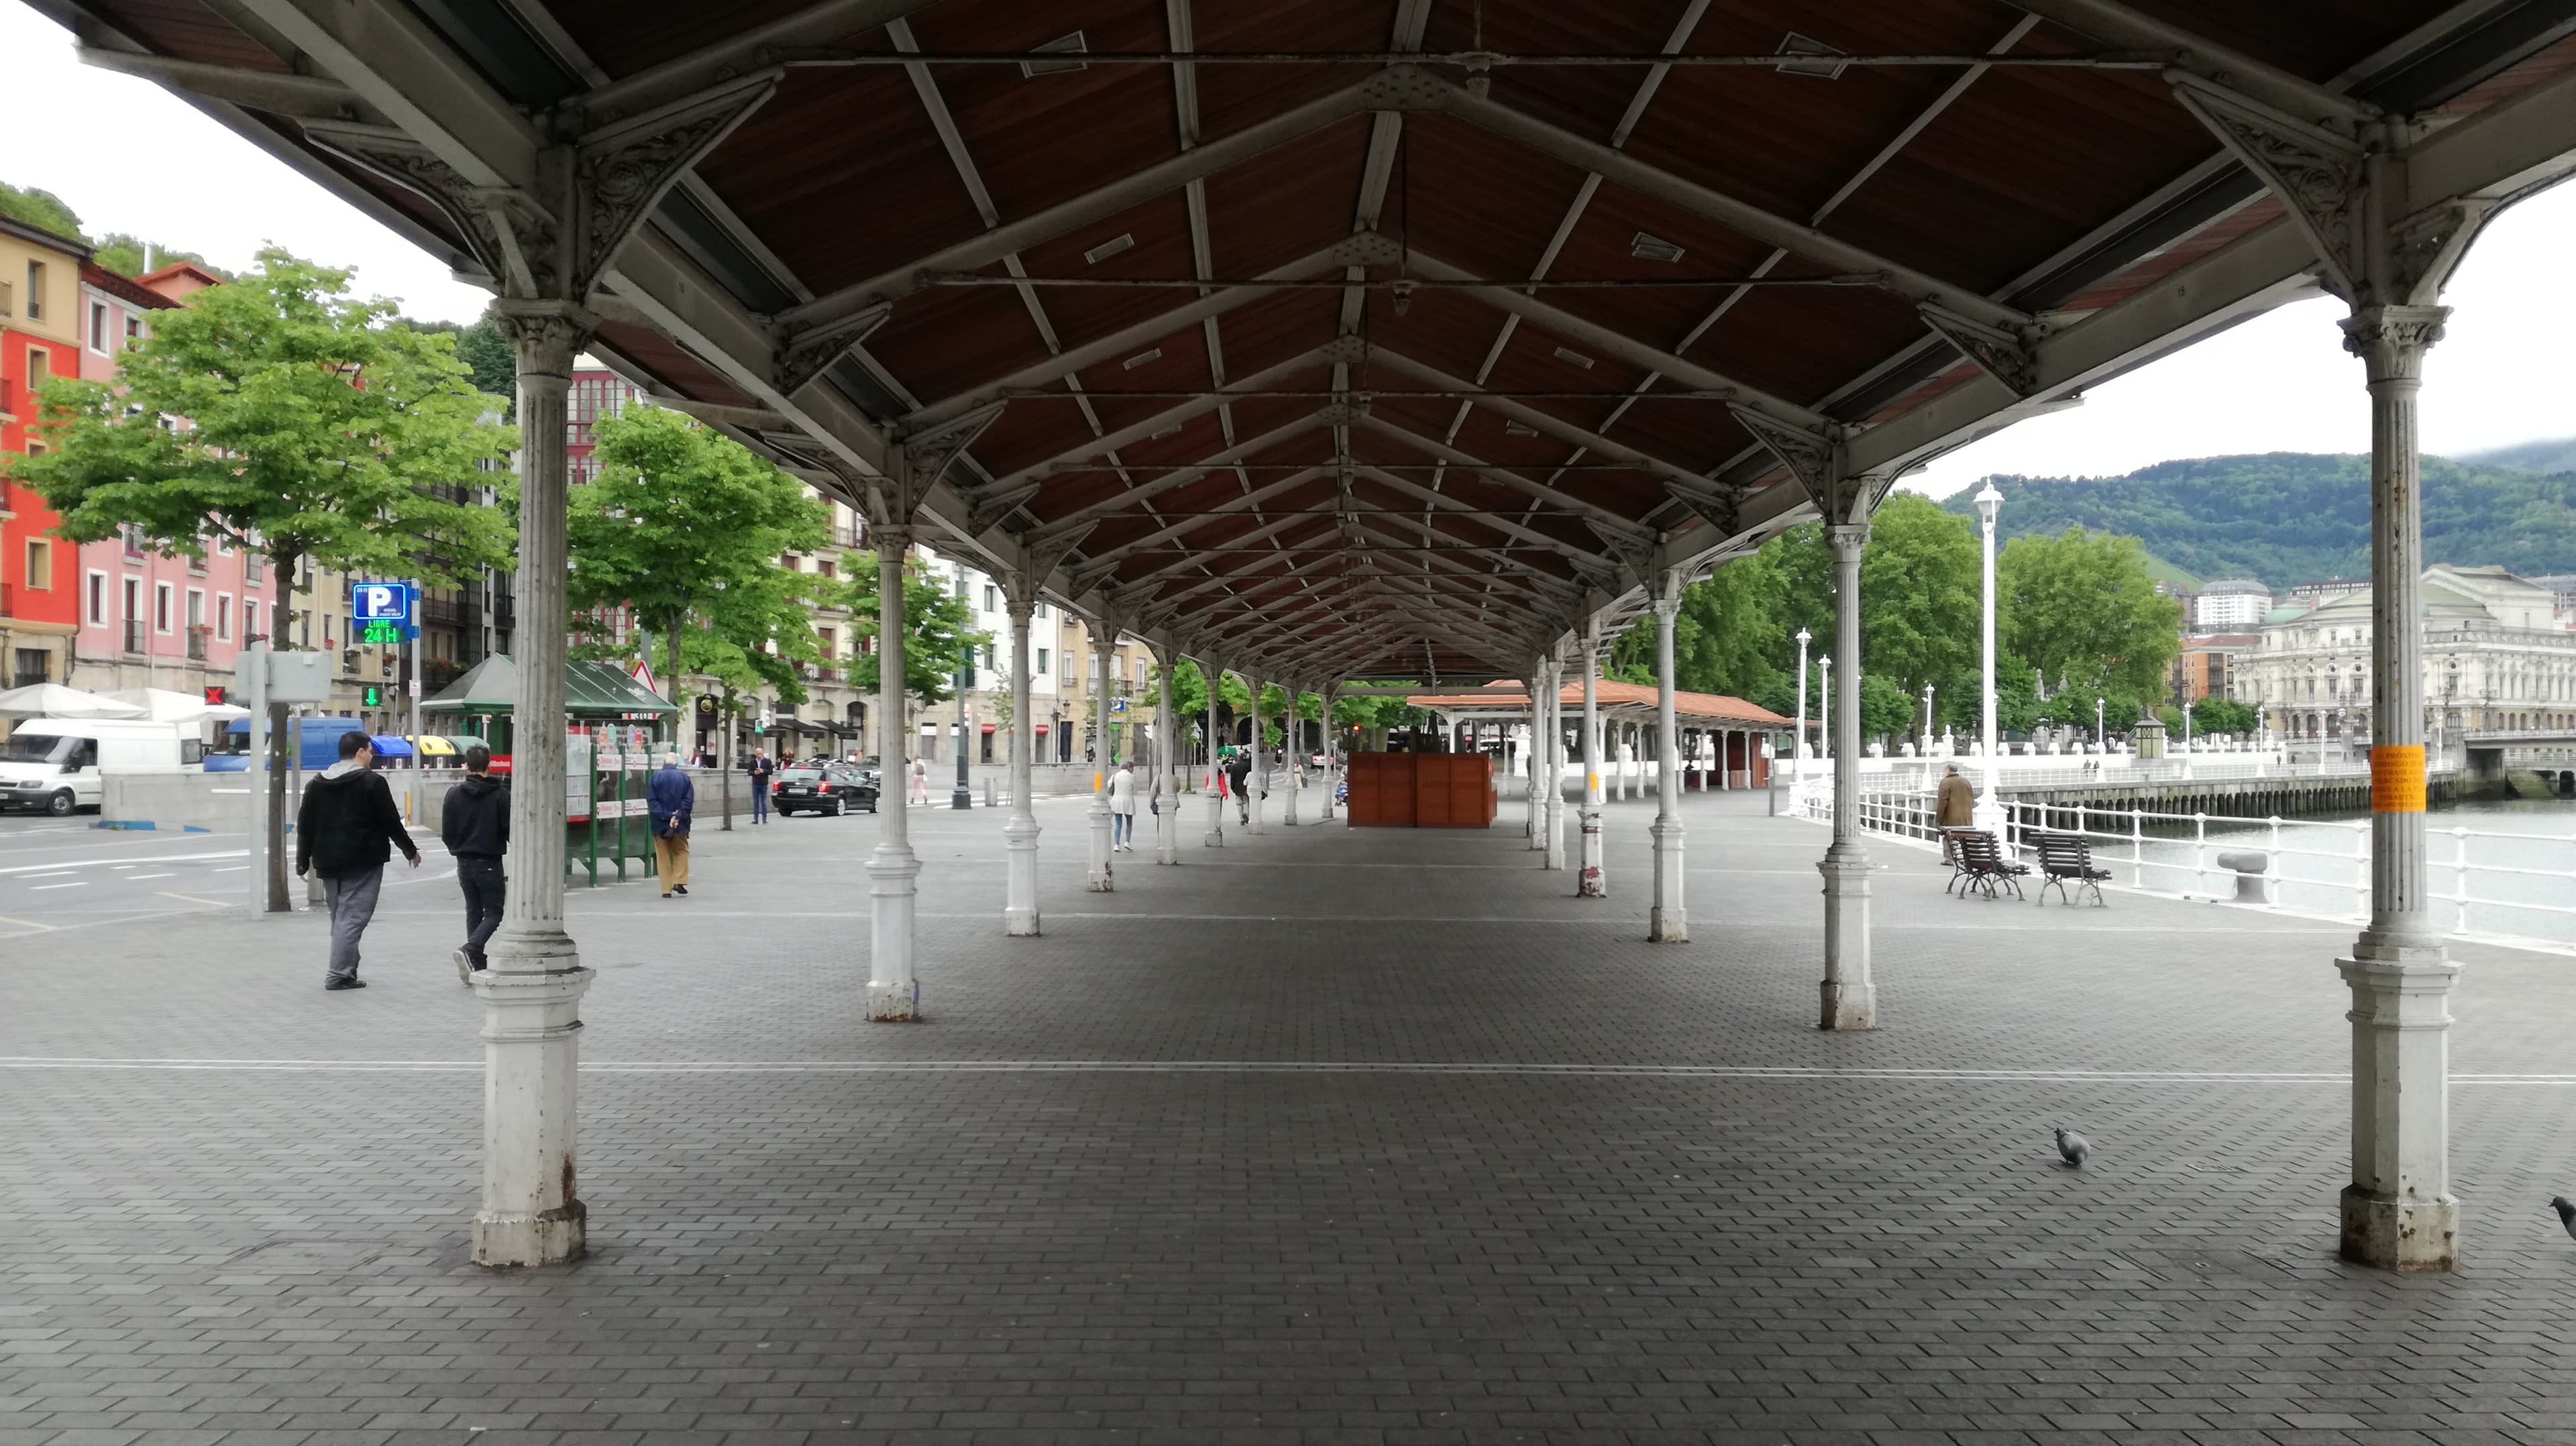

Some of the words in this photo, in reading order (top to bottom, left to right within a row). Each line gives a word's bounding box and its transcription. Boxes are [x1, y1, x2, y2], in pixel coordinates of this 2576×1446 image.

[368, 587, 391, 617] P
[368, 620, 390, 628] LIBRE
[364, 628, 382, 643] 24
[386, 628, 398, 643] H
